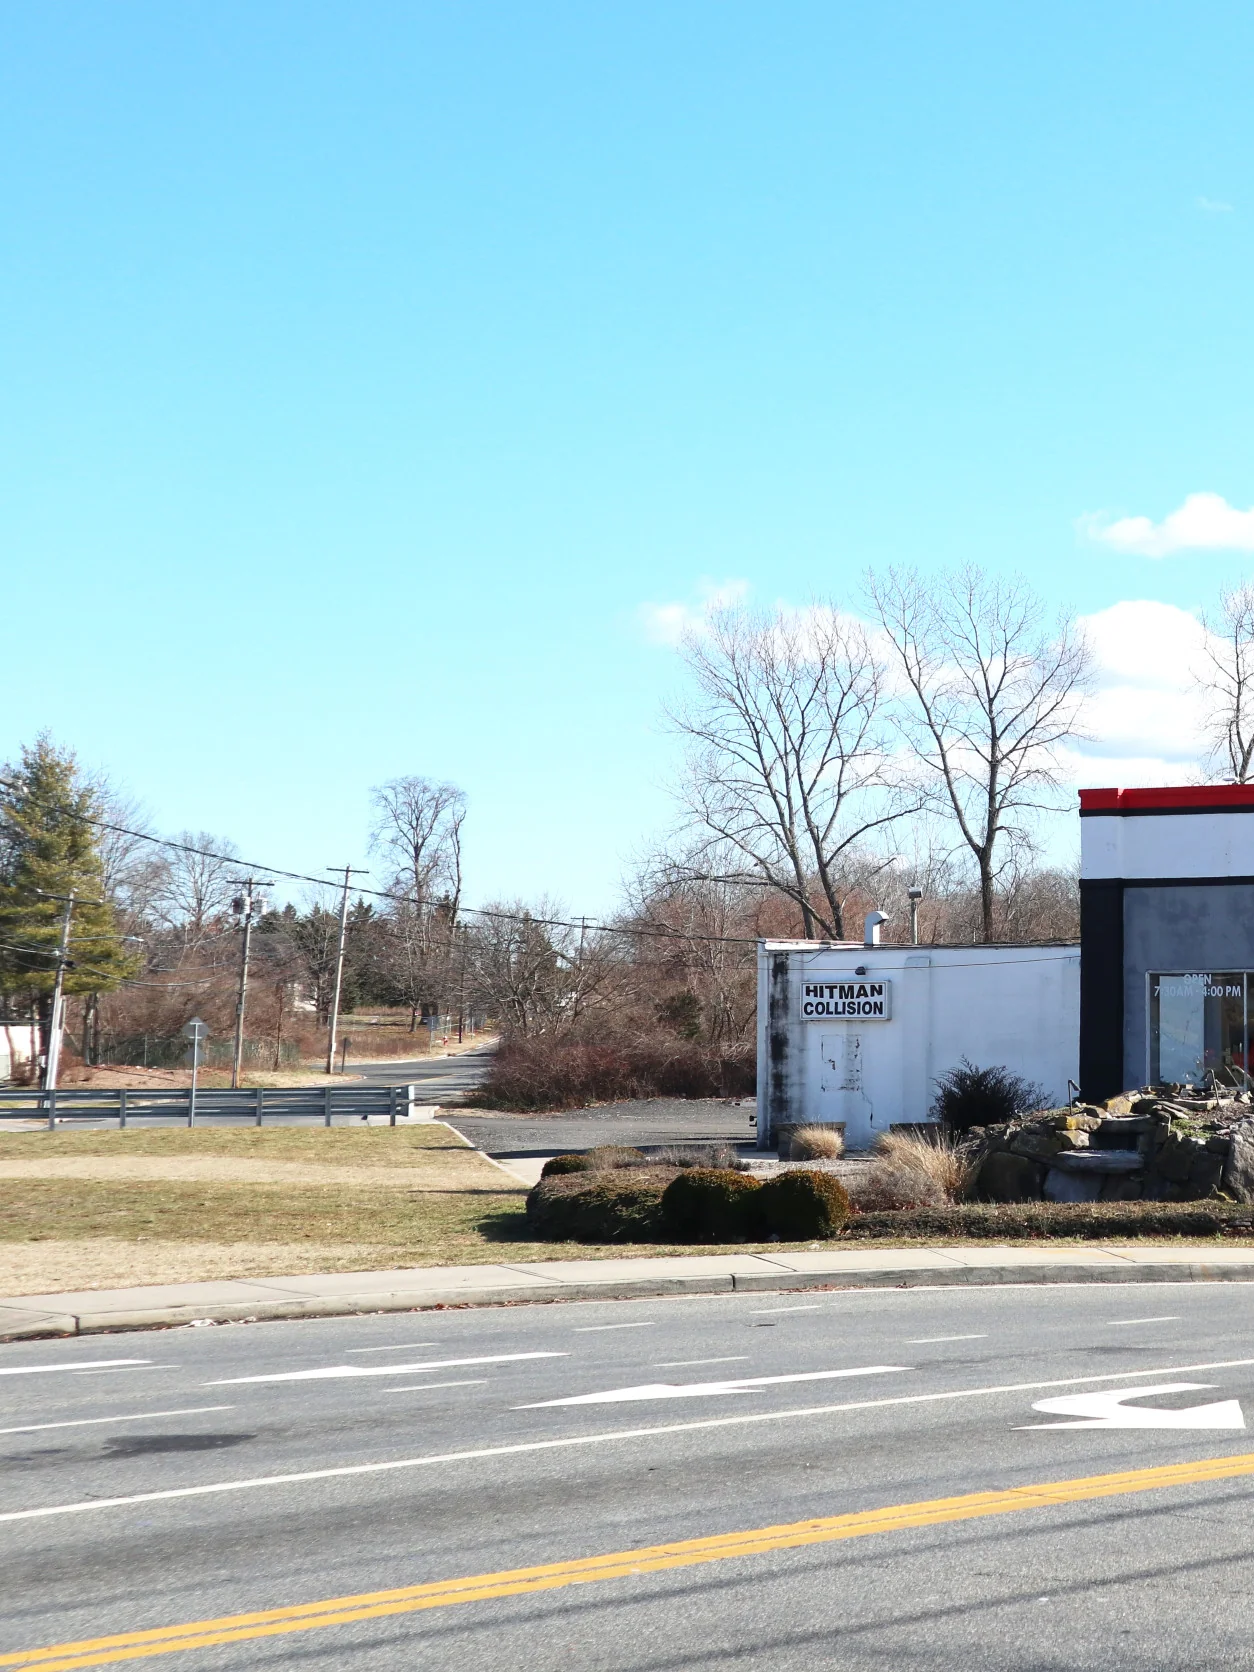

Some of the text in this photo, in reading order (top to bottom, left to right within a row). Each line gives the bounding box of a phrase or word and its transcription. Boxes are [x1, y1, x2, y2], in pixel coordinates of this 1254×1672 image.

[1183, 973, 1212, 985] OPEN
[805, 985, 883, 999] HITMAN
[1201, 985, 1223, 997] 4:00
[1225, 985, 1241, 997] PM
[803, 1001, 883, 1016] COLLISION
